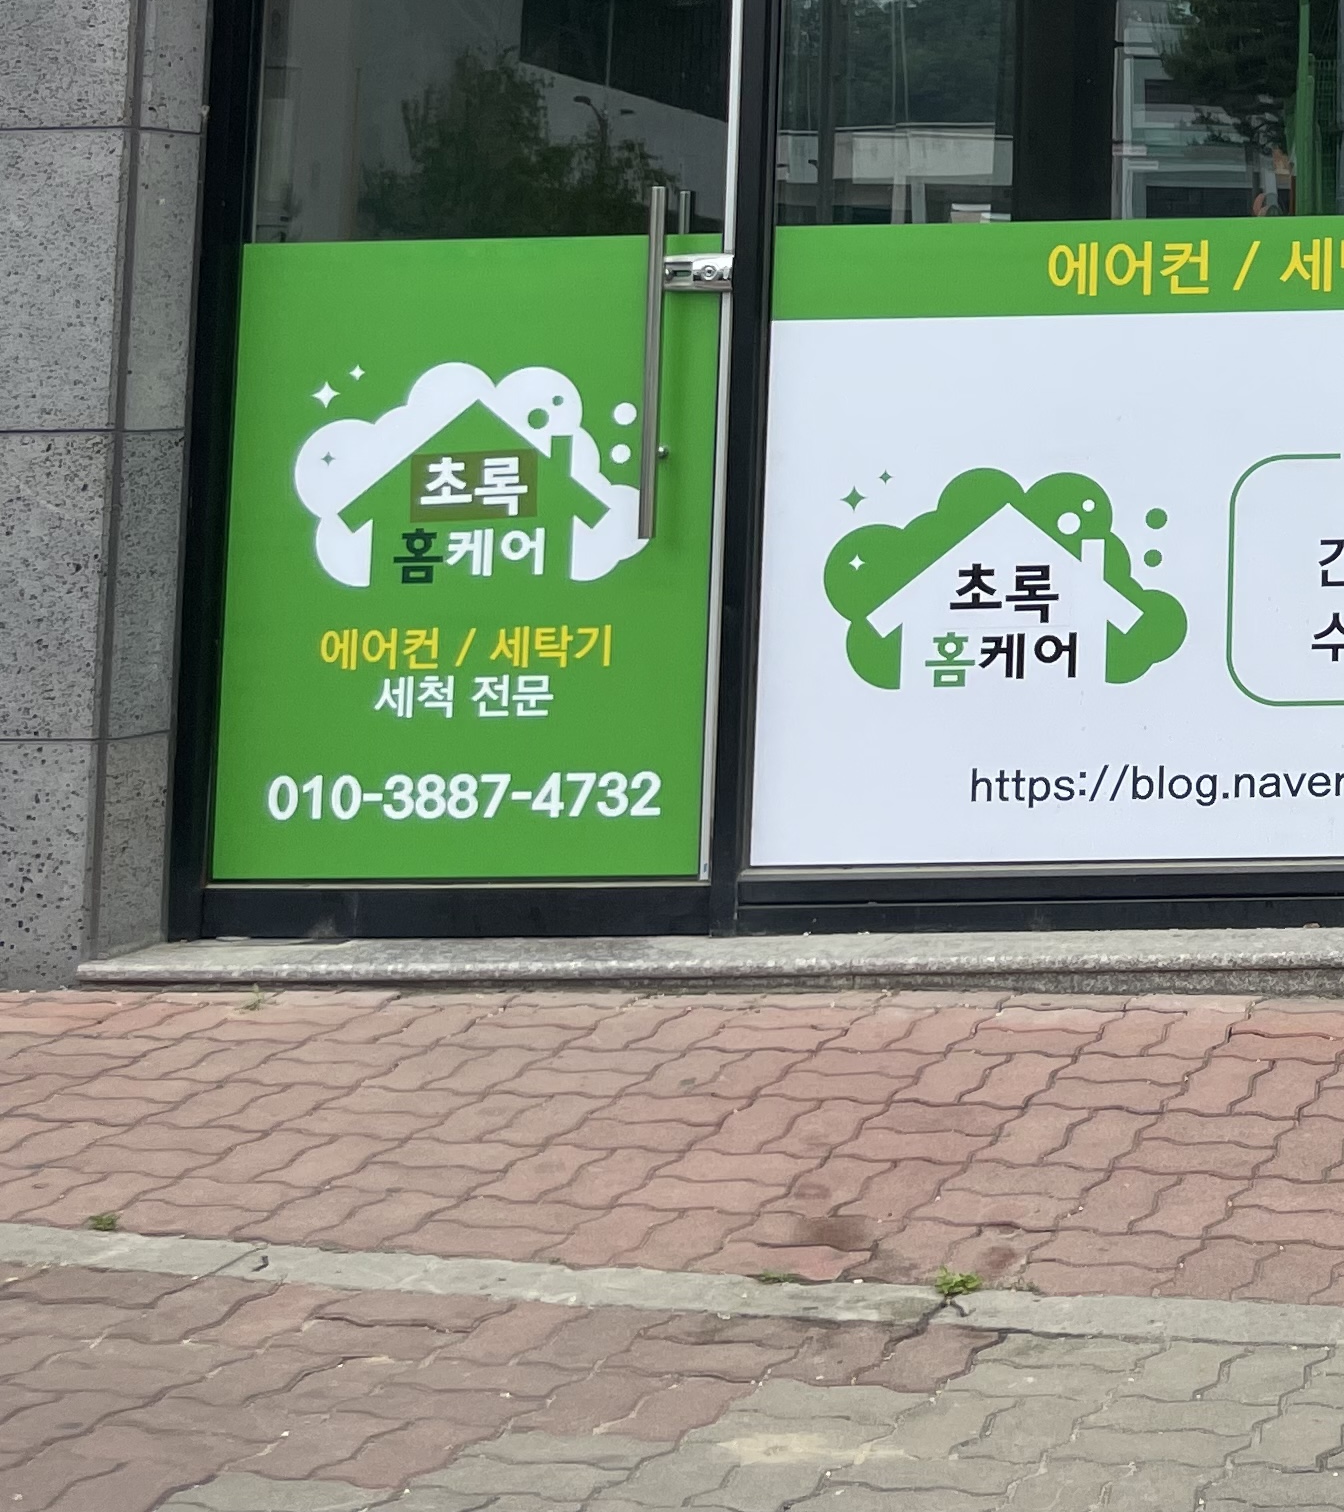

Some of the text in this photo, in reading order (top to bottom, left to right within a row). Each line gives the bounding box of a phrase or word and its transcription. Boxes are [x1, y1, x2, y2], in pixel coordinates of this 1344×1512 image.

[1049, 240, 1208, 296] 에어컨
[1233, 241, 1257, 290] /
[420, 456, 528, 516] 초록
[394, 528, 546, 584] 홈케어
[950, 563, 1059, 623] 초록
[321, 625, 611, 670] 에어컨 / 세탁기
[925, 632, 1077, 687] 홈케어
[374, 675, 553, 718] 세척 전문
[267, 771, 661, 820] 010-3887-4732
